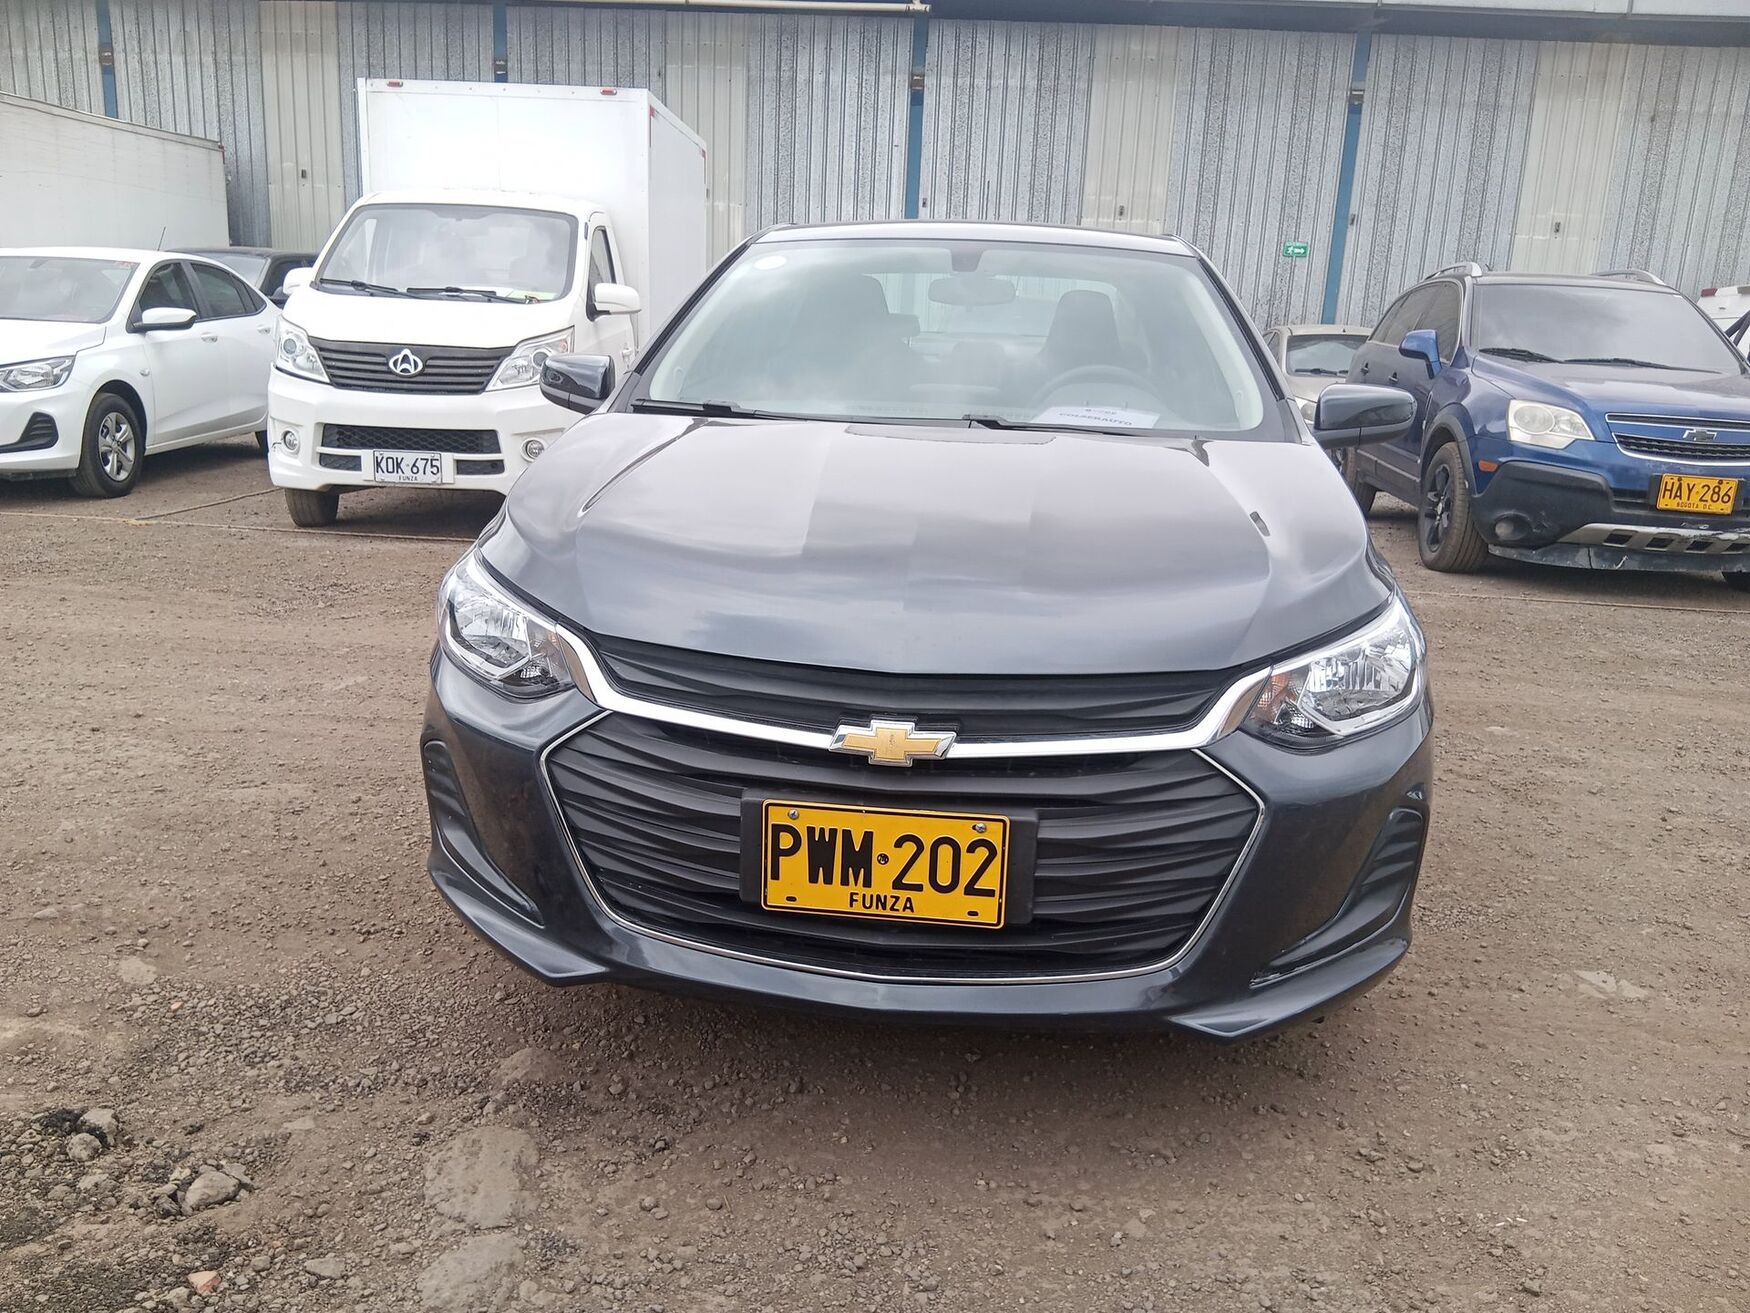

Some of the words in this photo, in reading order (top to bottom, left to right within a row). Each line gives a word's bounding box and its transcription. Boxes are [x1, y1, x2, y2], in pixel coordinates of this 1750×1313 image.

[375, 455, 405, 475] KOK
[410, 457, 440, 476] 675
[1662, 481, 1696, 501] HAY
[1698, 484, 1733, 504] 286
[770, 823, 873, 888] PWM
[891, 833, 998, 898] 202
[849, 892, 914, 913] FUNZA
